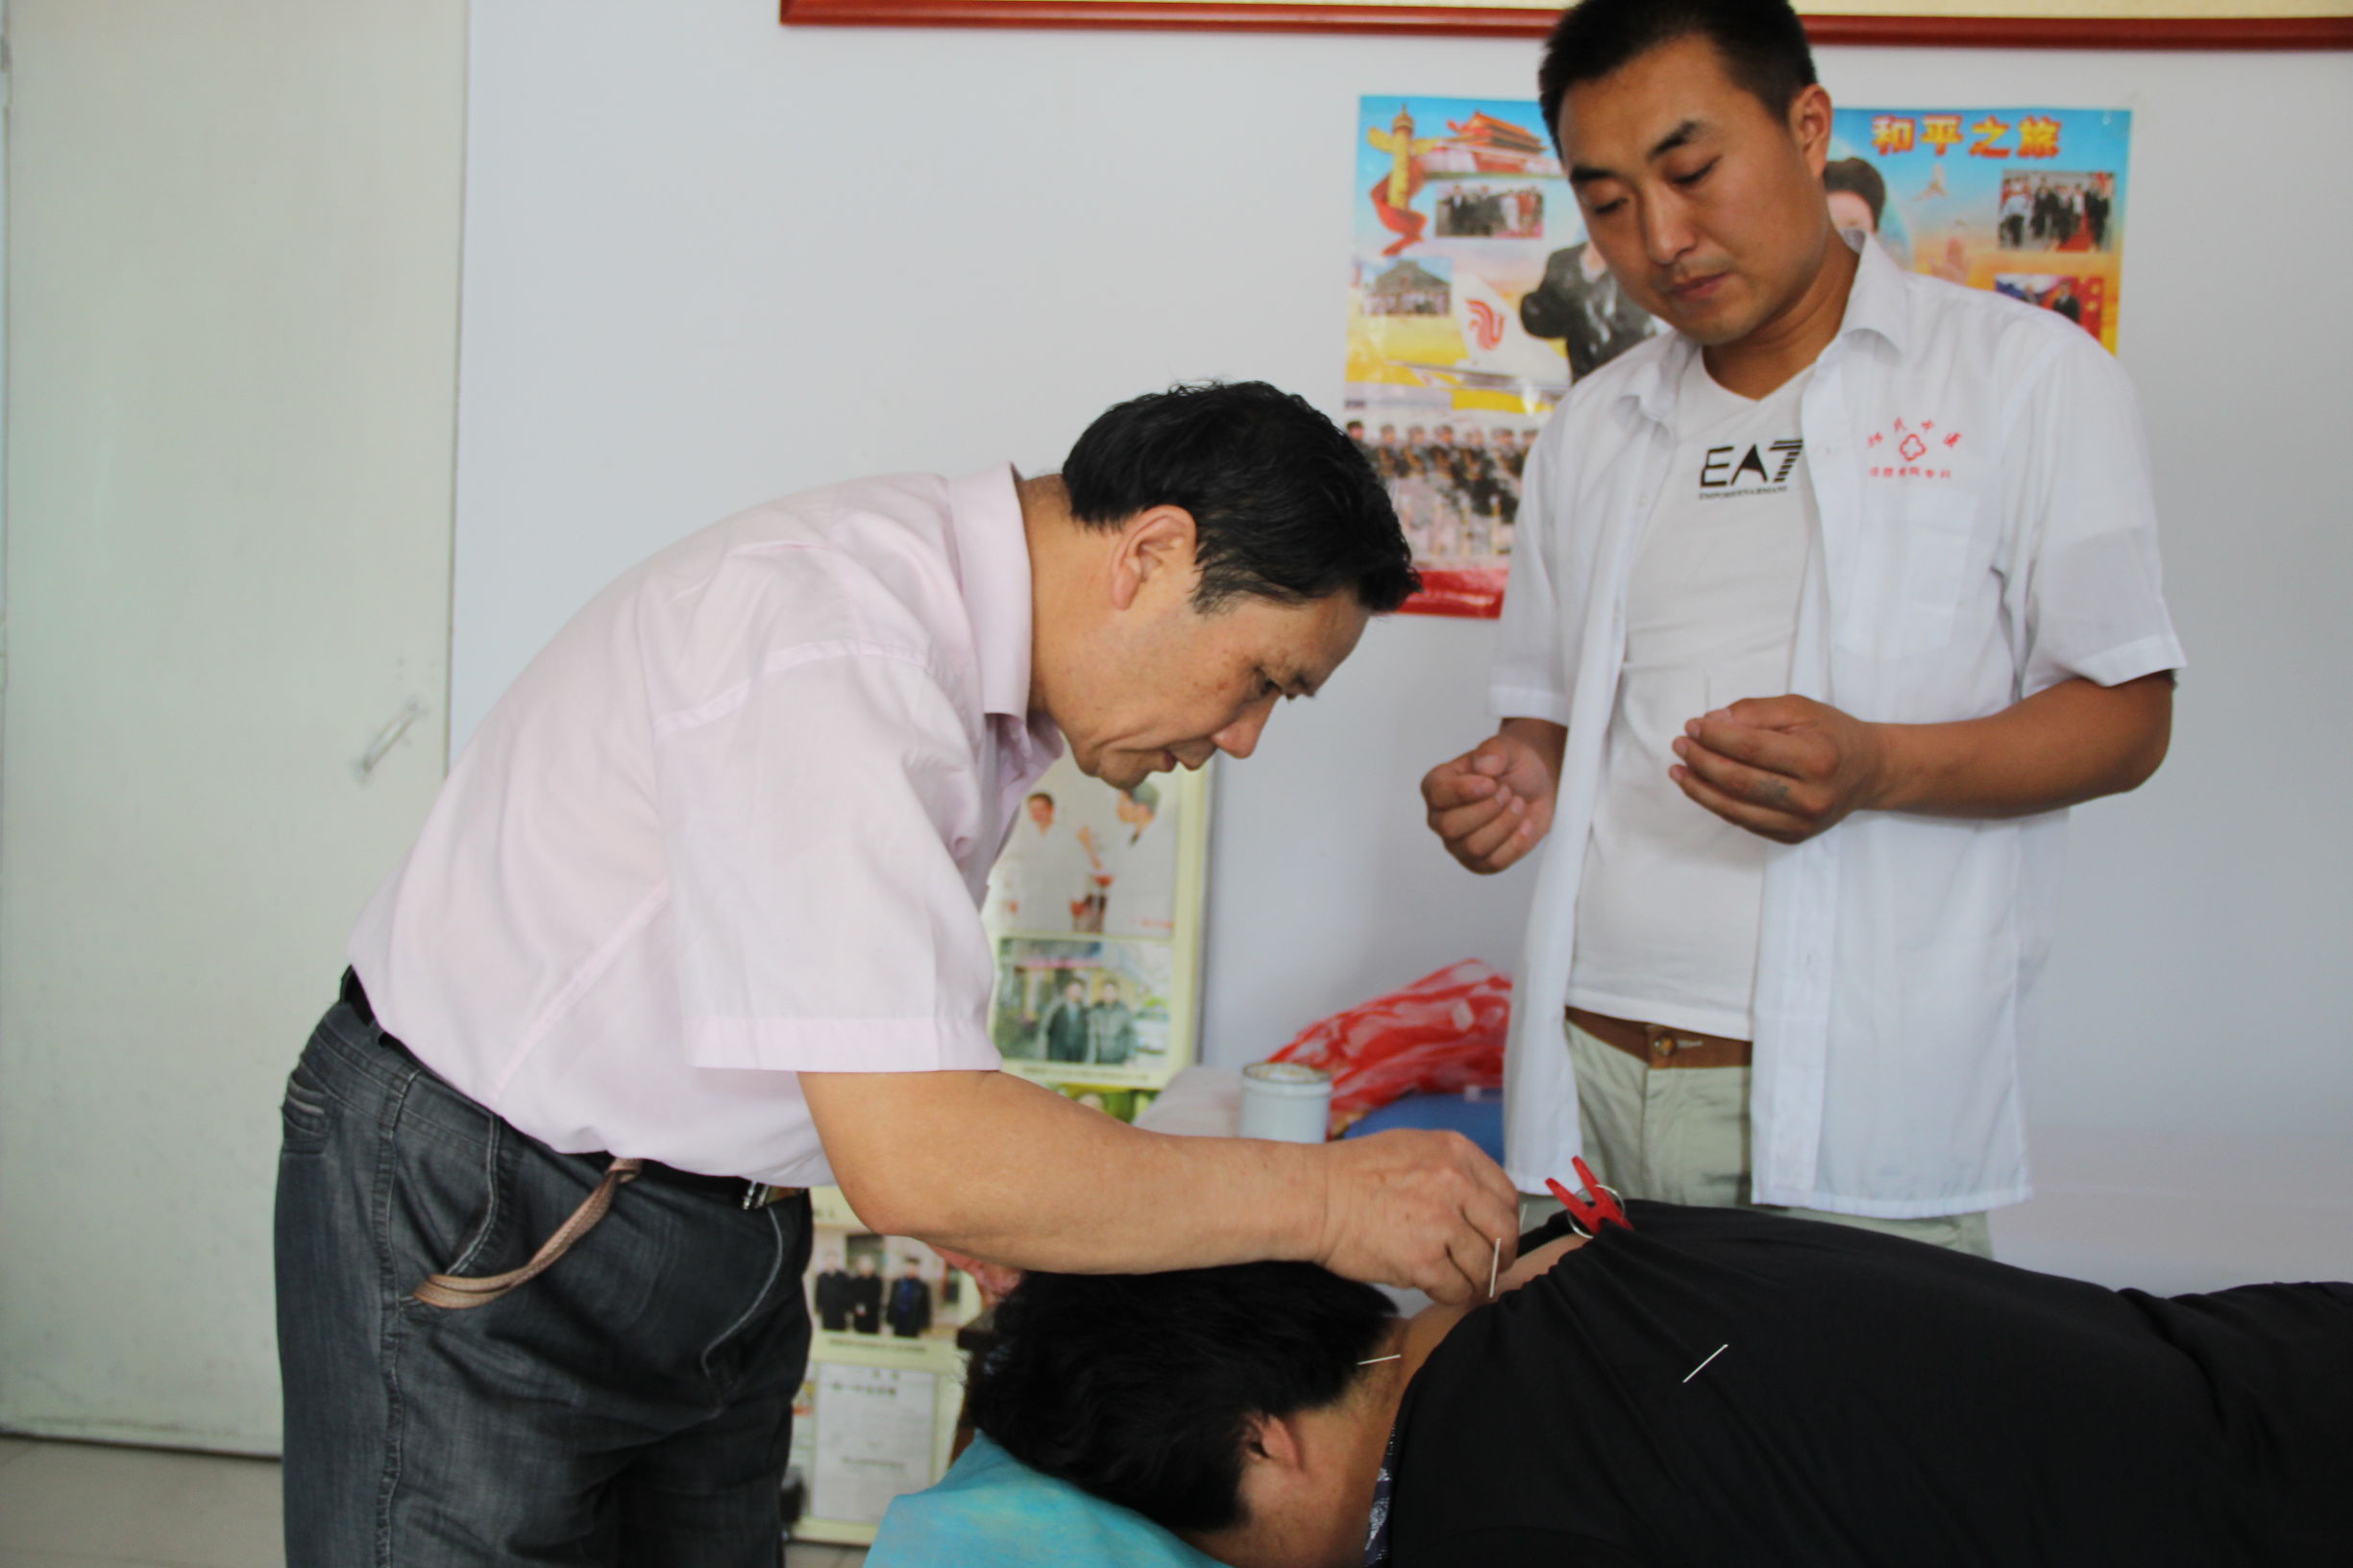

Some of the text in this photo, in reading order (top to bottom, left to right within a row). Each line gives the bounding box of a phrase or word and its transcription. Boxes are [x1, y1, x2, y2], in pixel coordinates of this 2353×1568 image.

[1873, 113, 2061, 158] 和平之旅
[1701, 439, 1802, 486] EA7
